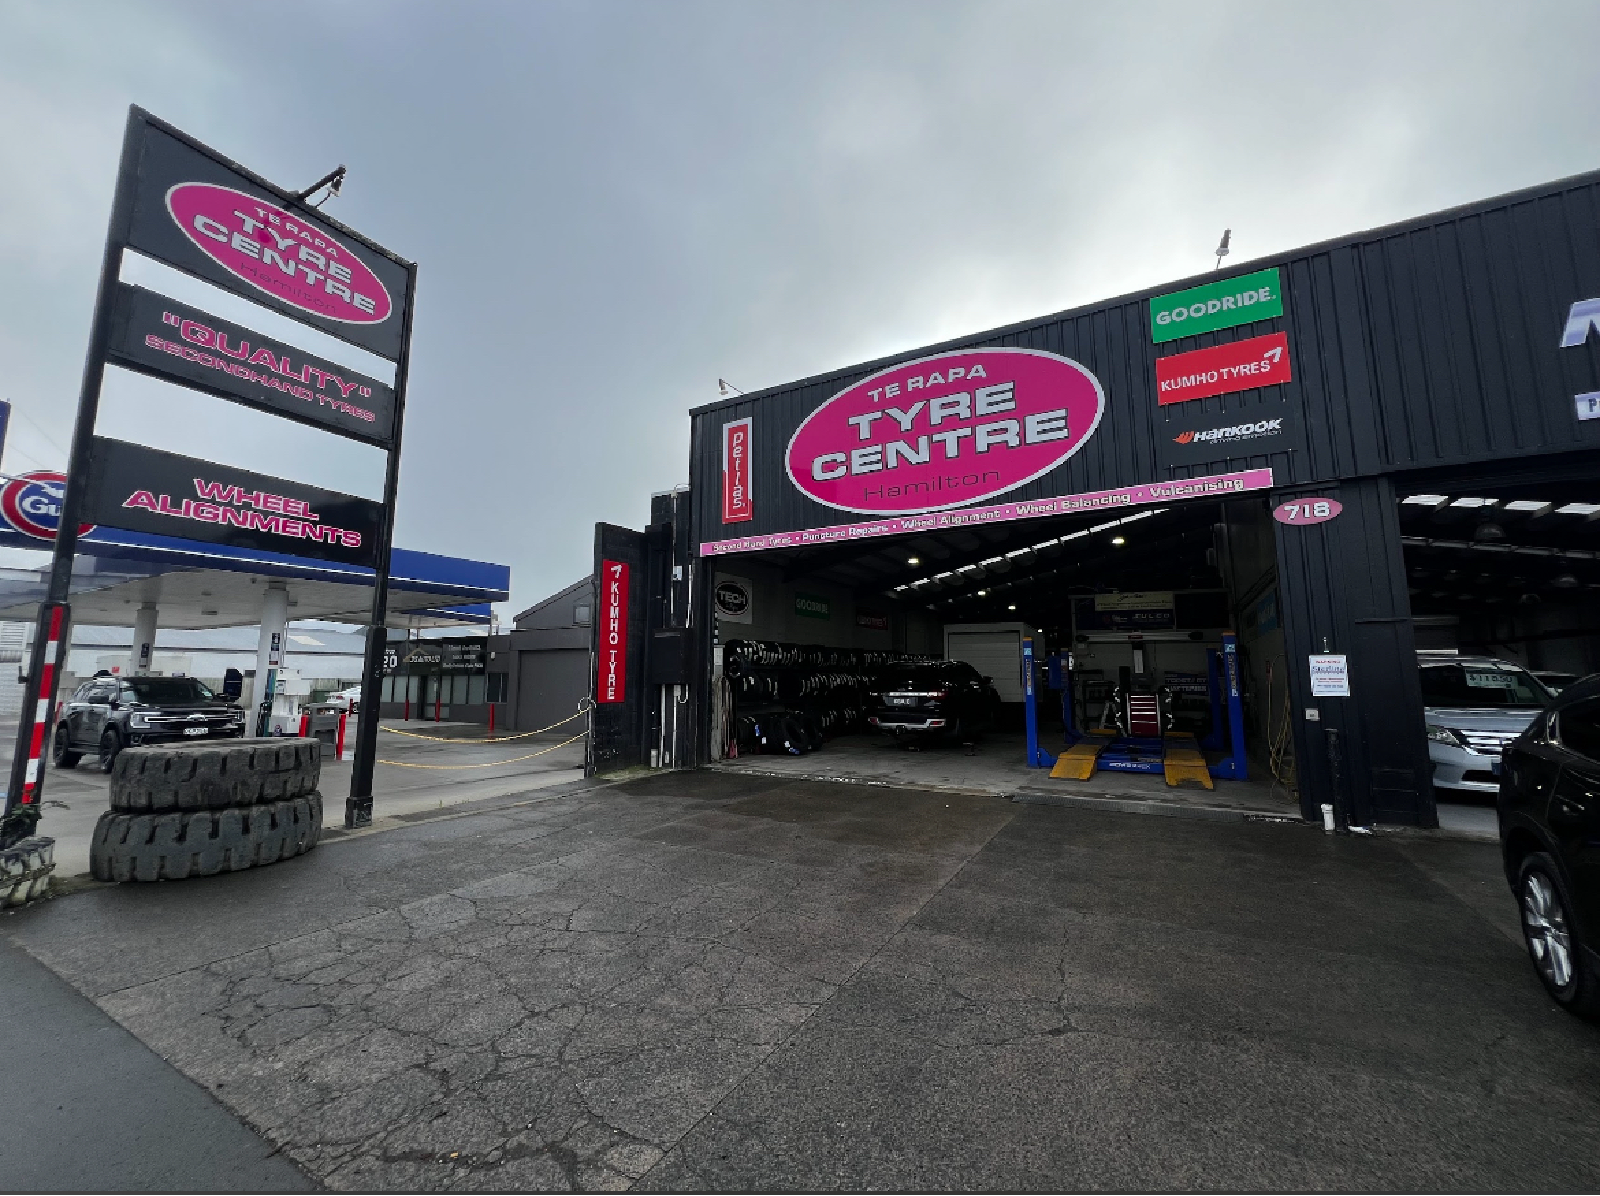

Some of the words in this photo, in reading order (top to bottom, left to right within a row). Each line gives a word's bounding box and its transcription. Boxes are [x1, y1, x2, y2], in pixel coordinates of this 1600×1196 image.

[233, 209, 352, 284] TYRE
[254, 207, 281, 227] TE
[285, 222, 340, 258] RAPA
[193, 214, 376, 315] CENTRE
[241, 263, 337, 312] Hamilton
[145, 334, 313, 402] SECONDHAND
[316, 393, 376, 424] TYRES
[162, 311, 372, 398] "QUALITY"
[1161, 370, 1218, 392] KUMHO
[1219, 360, 1271, 380] TYRES
[848, 380, 1017, 441] TYRE
[867, 385, 901, 403] TE
[907, 364, 988, 392] RAPA
[811, 408, 1070, 481] CENTRE
[193, 479, 320, 520] WHEEL
[802, 529, 846, 543] Puncture
[848, 524, 889, 540] Repairs
[901, 516, 936, 530] Wheel
[940, 507, 1001, 526] Alignment
[1016, 501, 1057, 515] Wheel
[1062, 492, 1131, 511] Balancing
[1150, 478, 1244, 498] Vulcanising
[863, 470, 1000, 502] Hamilton
[1284, 502, 1330, 520] 718
[122, 490, 362, 548] ALIGNMENTS
[609, 581, 621, 645] KUMHO
[718, 590, 746, 605] TECH
[606, 650, 619, 700] TYRE
